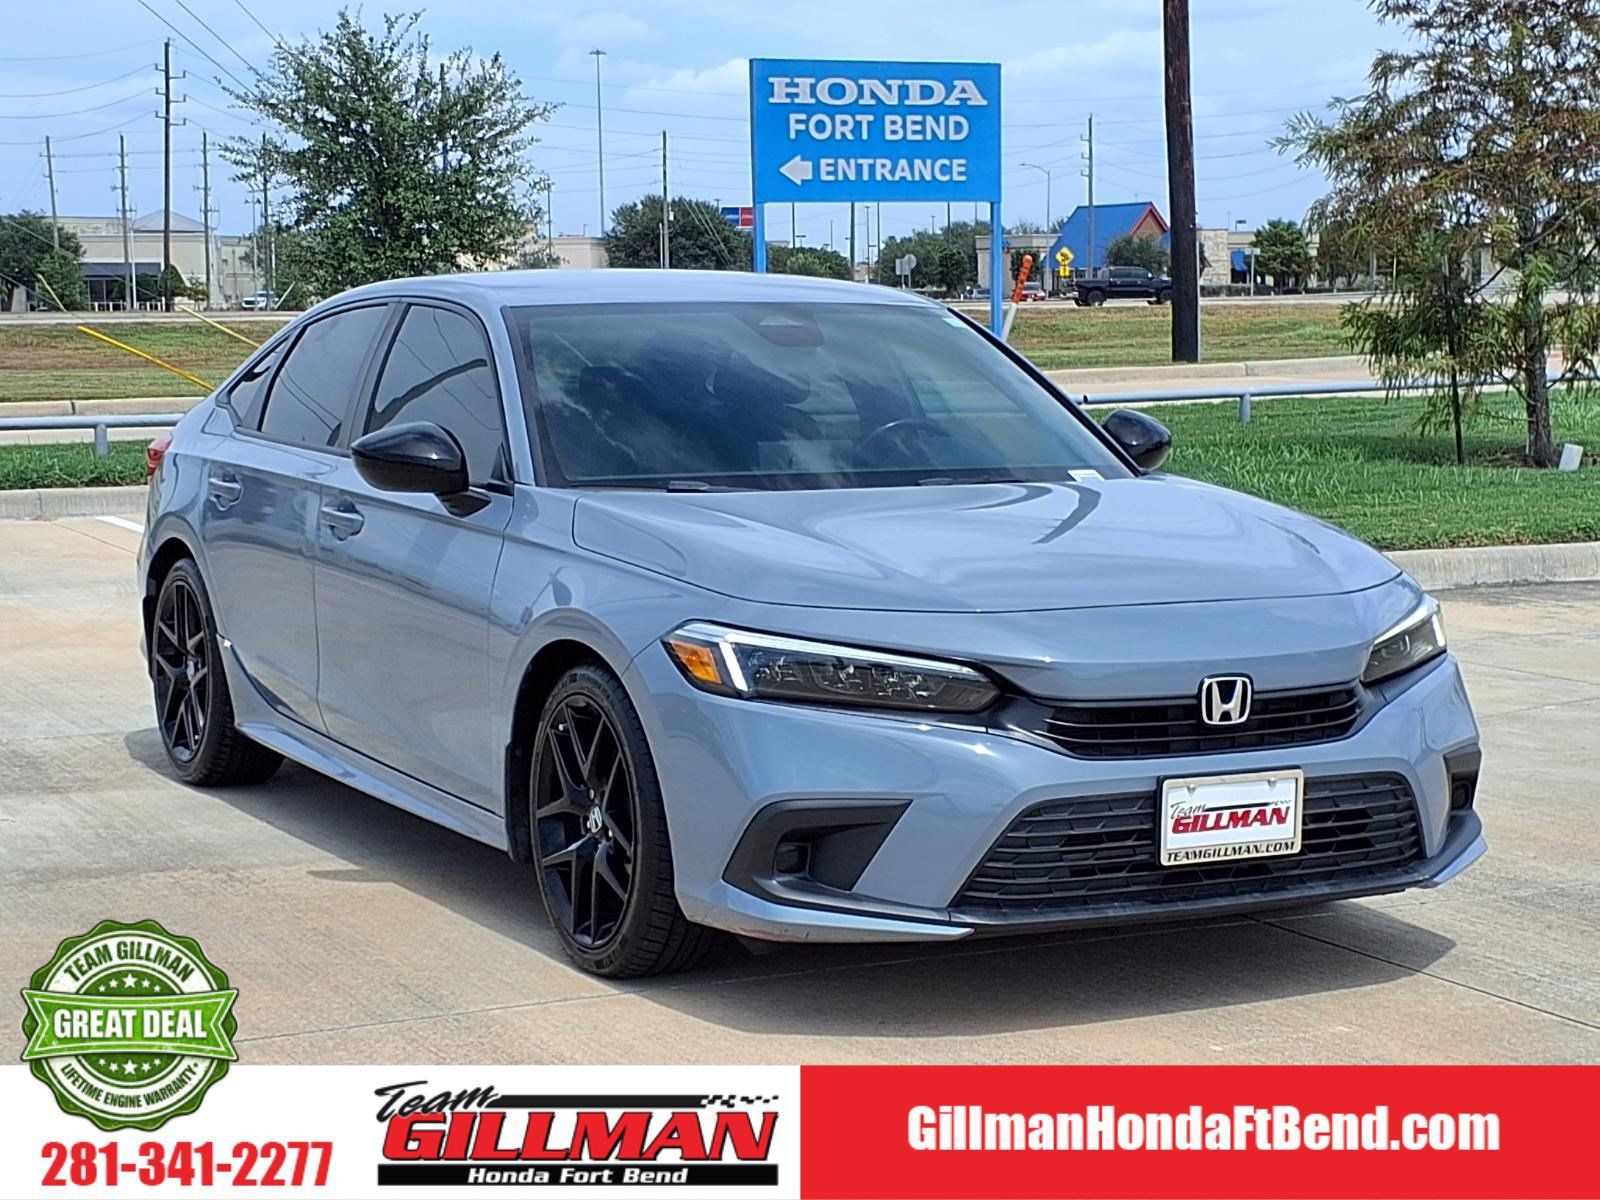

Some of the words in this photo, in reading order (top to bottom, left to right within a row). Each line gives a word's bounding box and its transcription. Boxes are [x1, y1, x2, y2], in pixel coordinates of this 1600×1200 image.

[768, 77, 988, 106] HONDA
[789, 113, 875, 140] FORT
[884, 115, 970, 141] BEND
[819, 158, 968, 182] ENTRANCE
[1170, 801, 1206, 820] Team
[1171, 806, 1291, 834] GILLMAN
[1166, 841, 1296, 863] TEAMGILLMAN.COM
